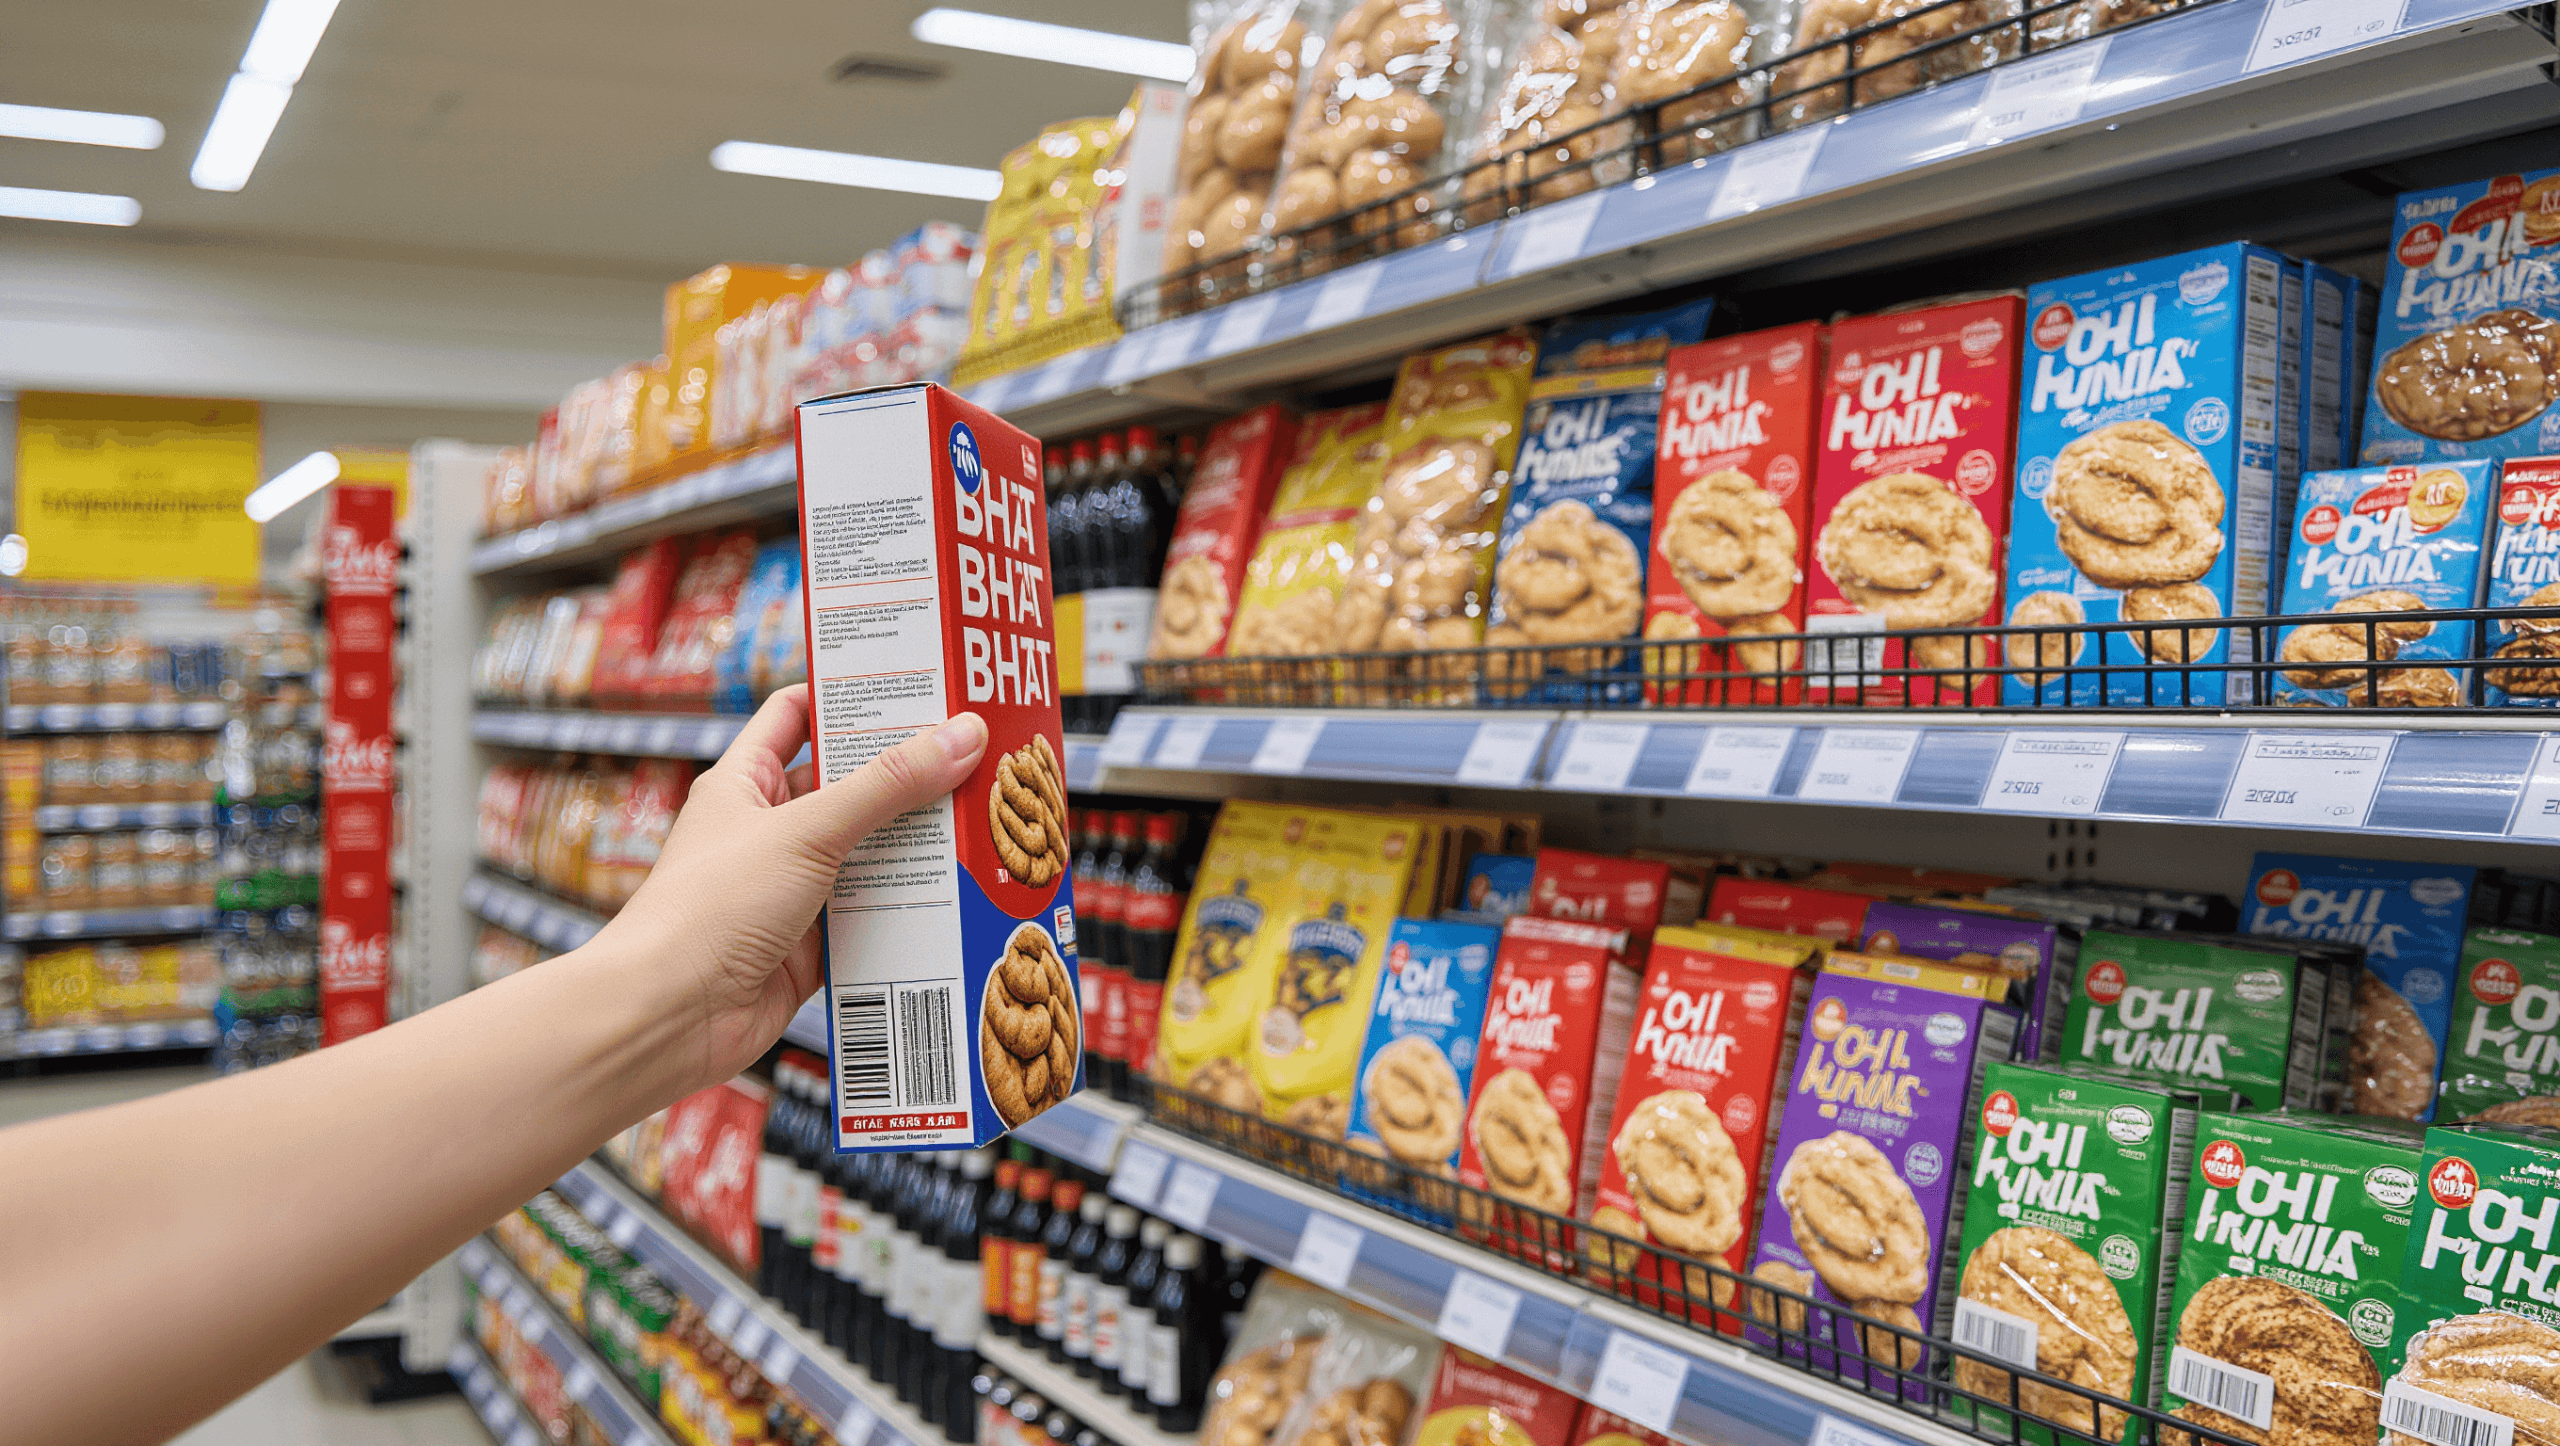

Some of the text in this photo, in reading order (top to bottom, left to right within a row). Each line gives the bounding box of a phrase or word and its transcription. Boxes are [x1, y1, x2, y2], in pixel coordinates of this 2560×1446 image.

[955, 468, 1036, 555] BHAT
[957, 543, 1043, 629] BHAT
[963, 626, 1051, 708] BHAT
